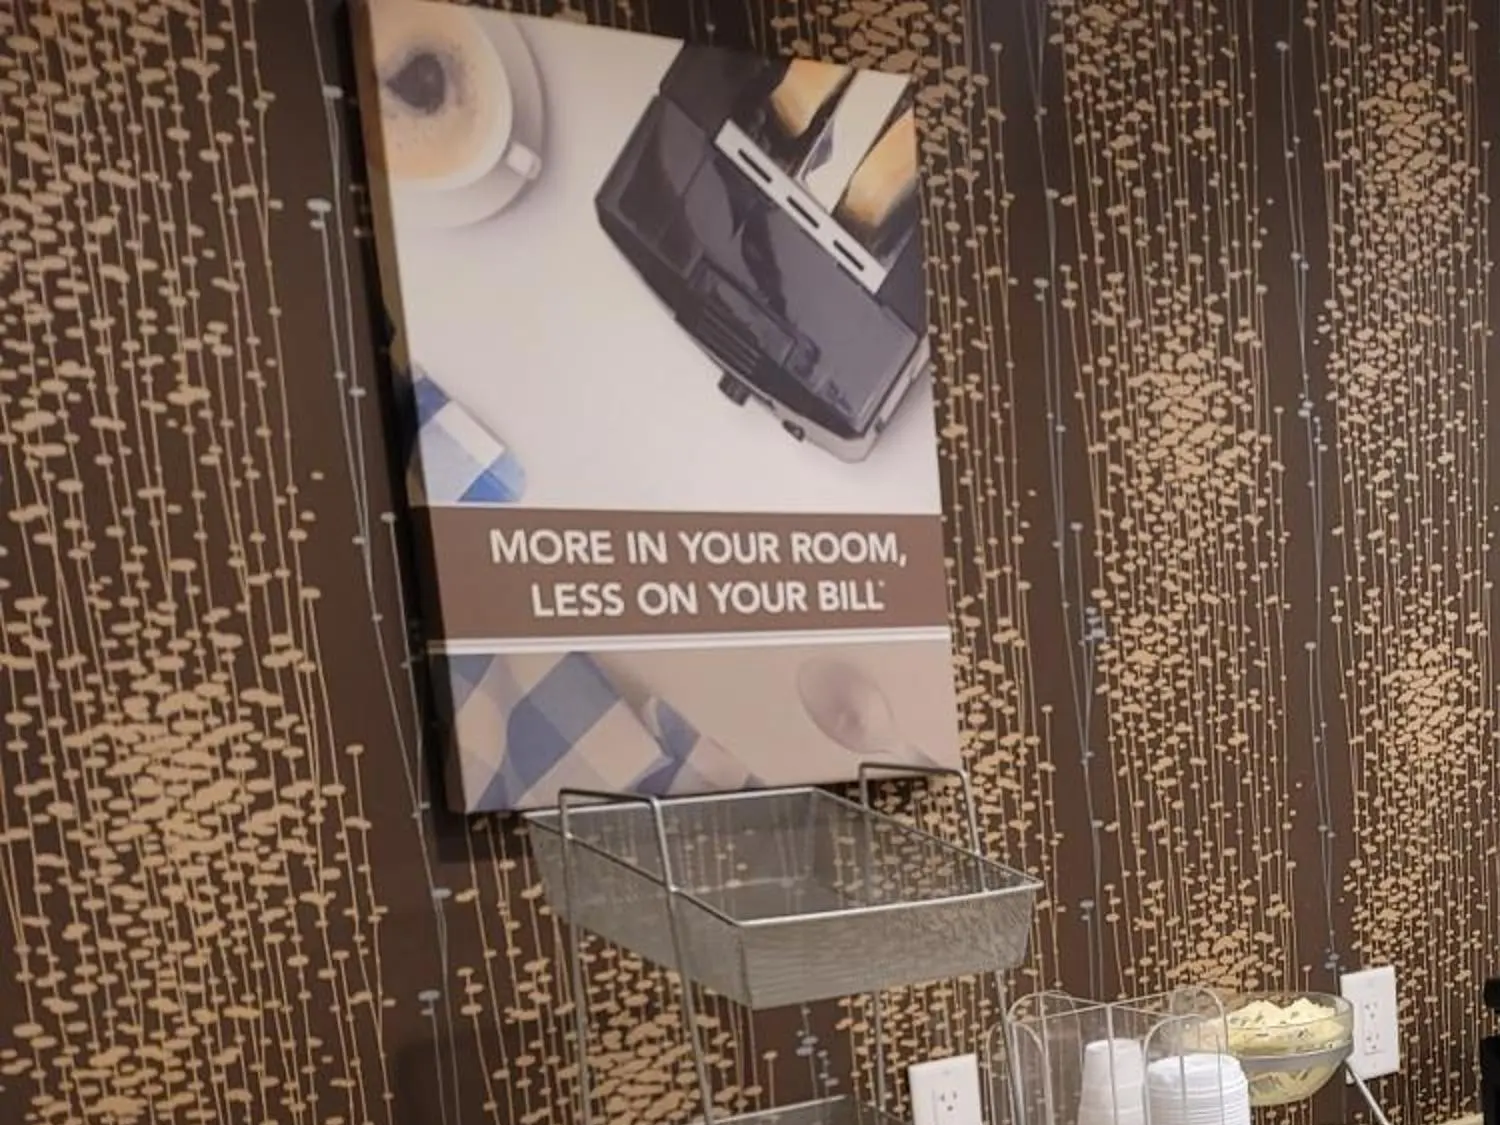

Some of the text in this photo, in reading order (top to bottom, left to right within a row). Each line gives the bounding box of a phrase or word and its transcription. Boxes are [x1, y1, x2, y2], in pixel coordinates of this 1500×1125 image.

[490, 528, 907, 567] MORE IN YOUR ROOM,
[531, 583, 625, 617] LESS
[637, 582, 698, 616] ON
[708, 580, 808, 614] YOUR
